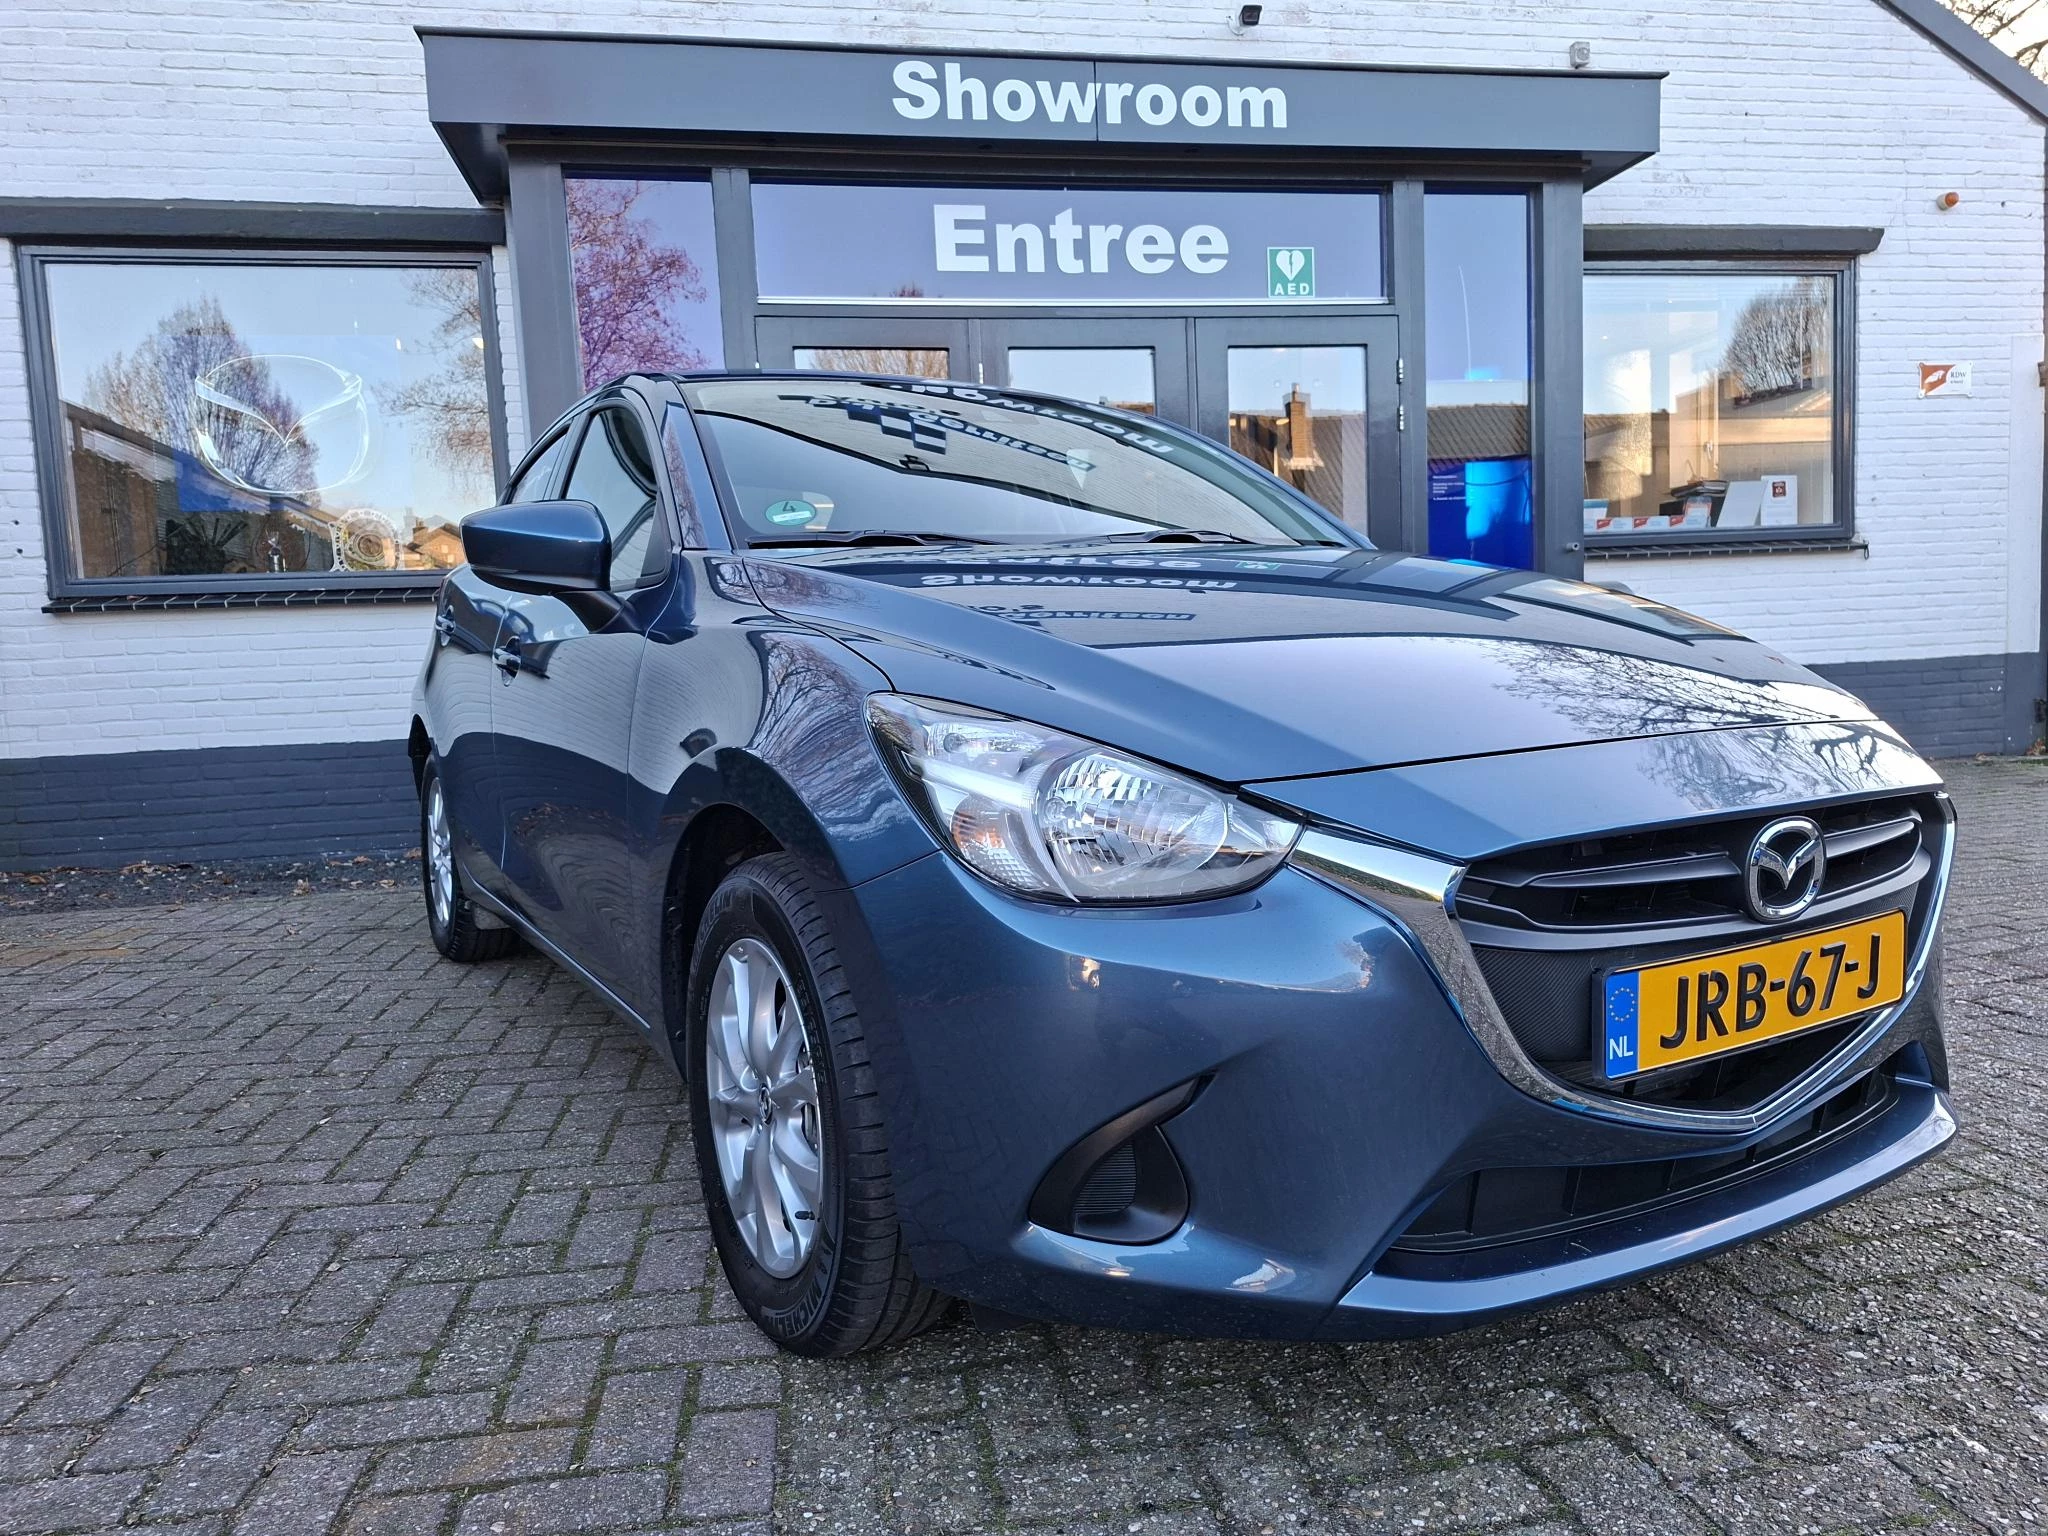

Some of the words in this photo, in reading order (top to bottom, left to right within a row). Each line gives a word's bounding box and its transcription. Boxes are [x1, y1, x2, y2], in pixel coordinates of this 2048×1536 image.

[891, 60, 1289, 129] Showroom
[933, 204, 1230, 275] Entree
[1274, 282, 1310, 295] AED
[1659, 932, 1881, 1050] JRB-67-J
[1609, 1035, 1634, 1061] NL
